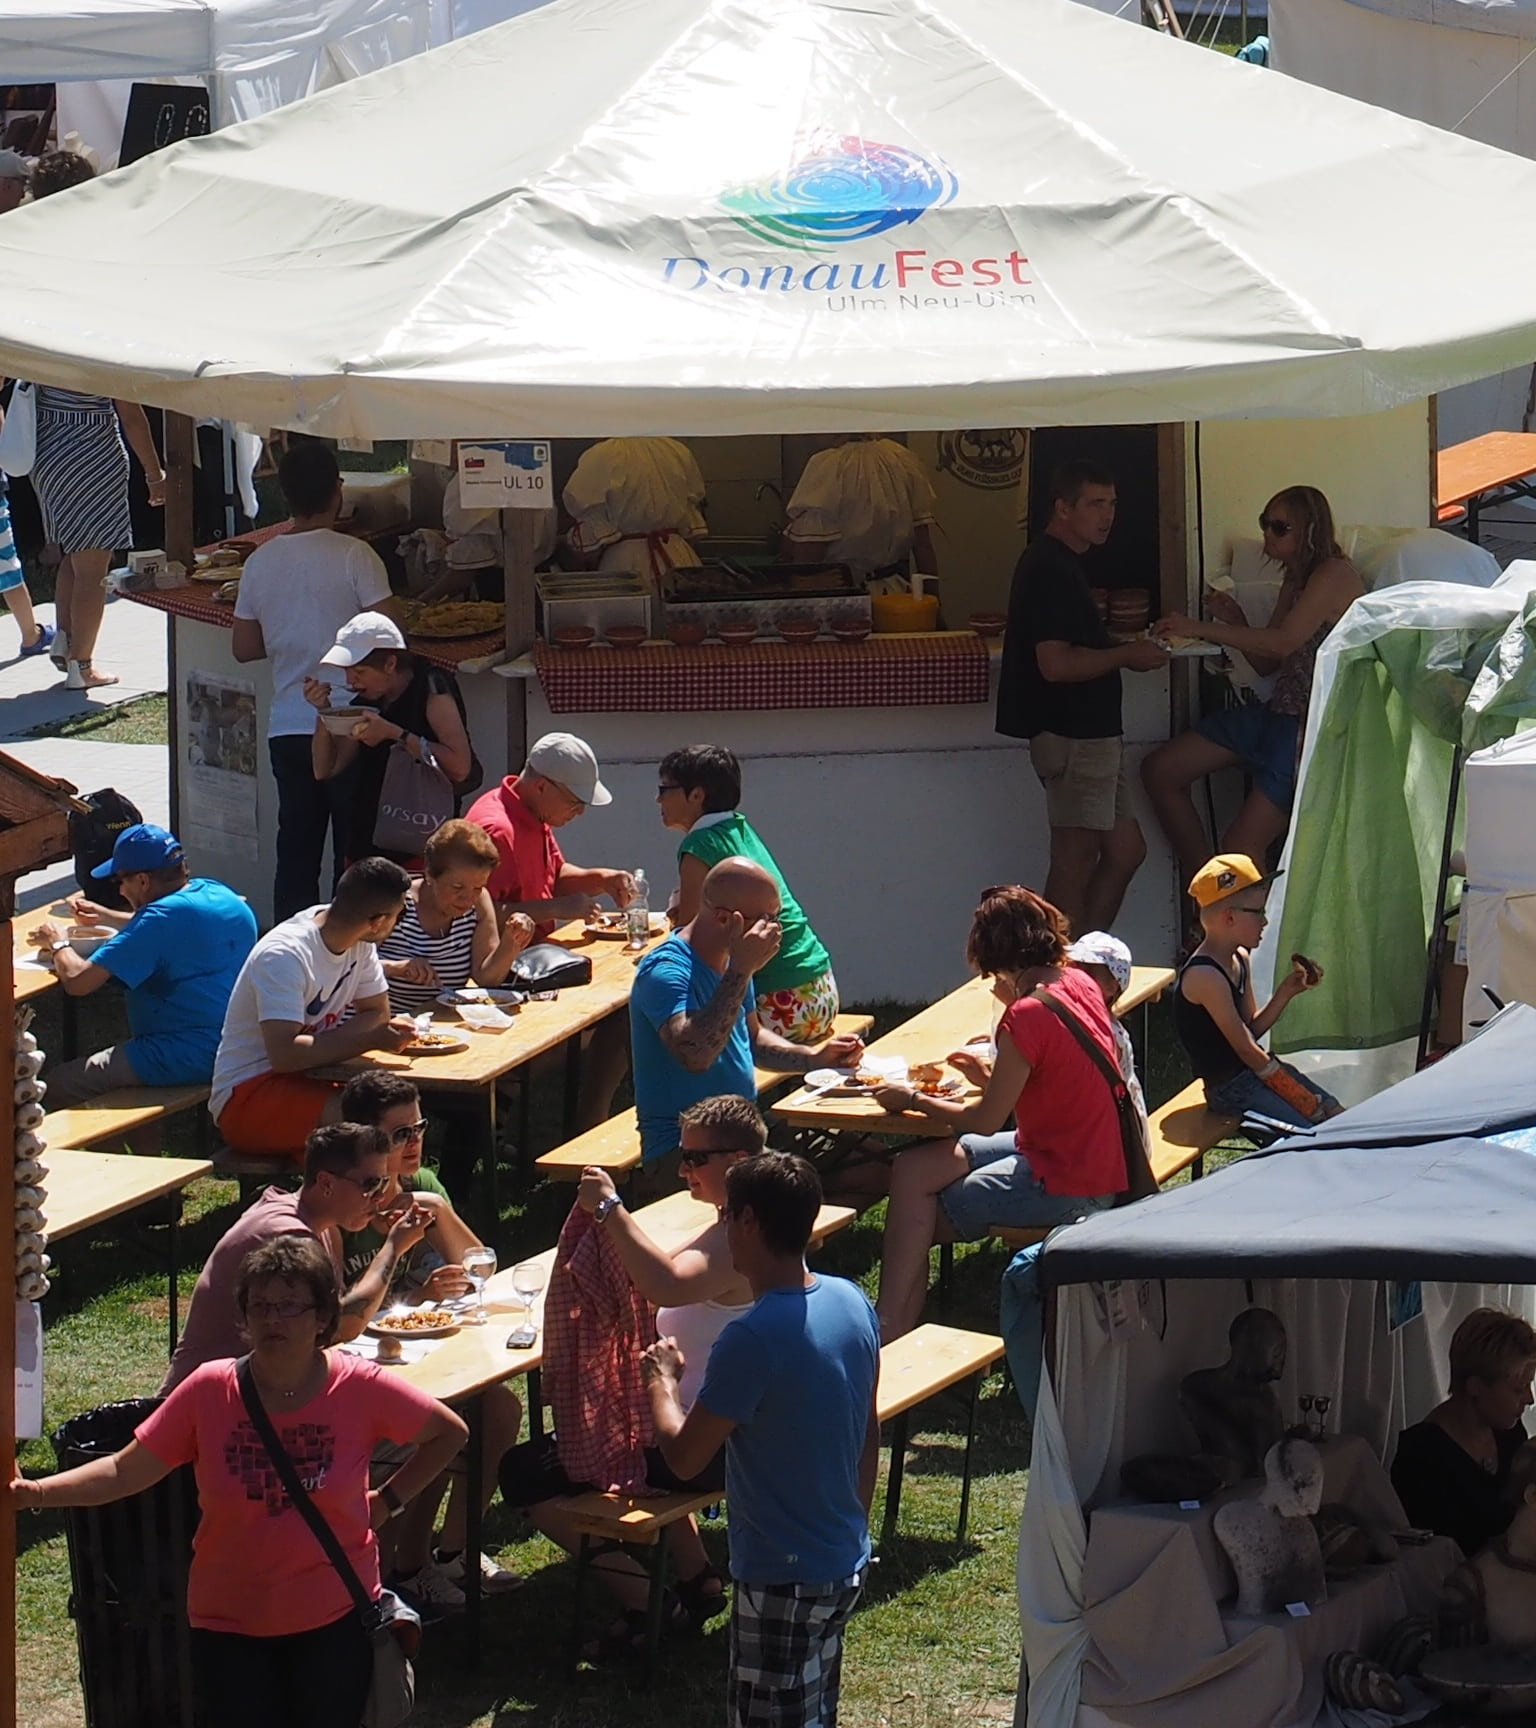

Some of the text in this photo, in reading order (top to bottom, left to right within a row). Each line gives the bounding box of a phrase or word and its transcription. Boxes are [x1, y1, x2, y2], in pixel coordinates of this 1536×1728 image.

[661, 249, 1032, 293] DonauFest
[827, 292, 1036, 312] Ulm Neu-Ulm
[504, 475, 522, 489] UL
[527, 476, 544, 489] 10
[382, 804, 447, 834] orsay
